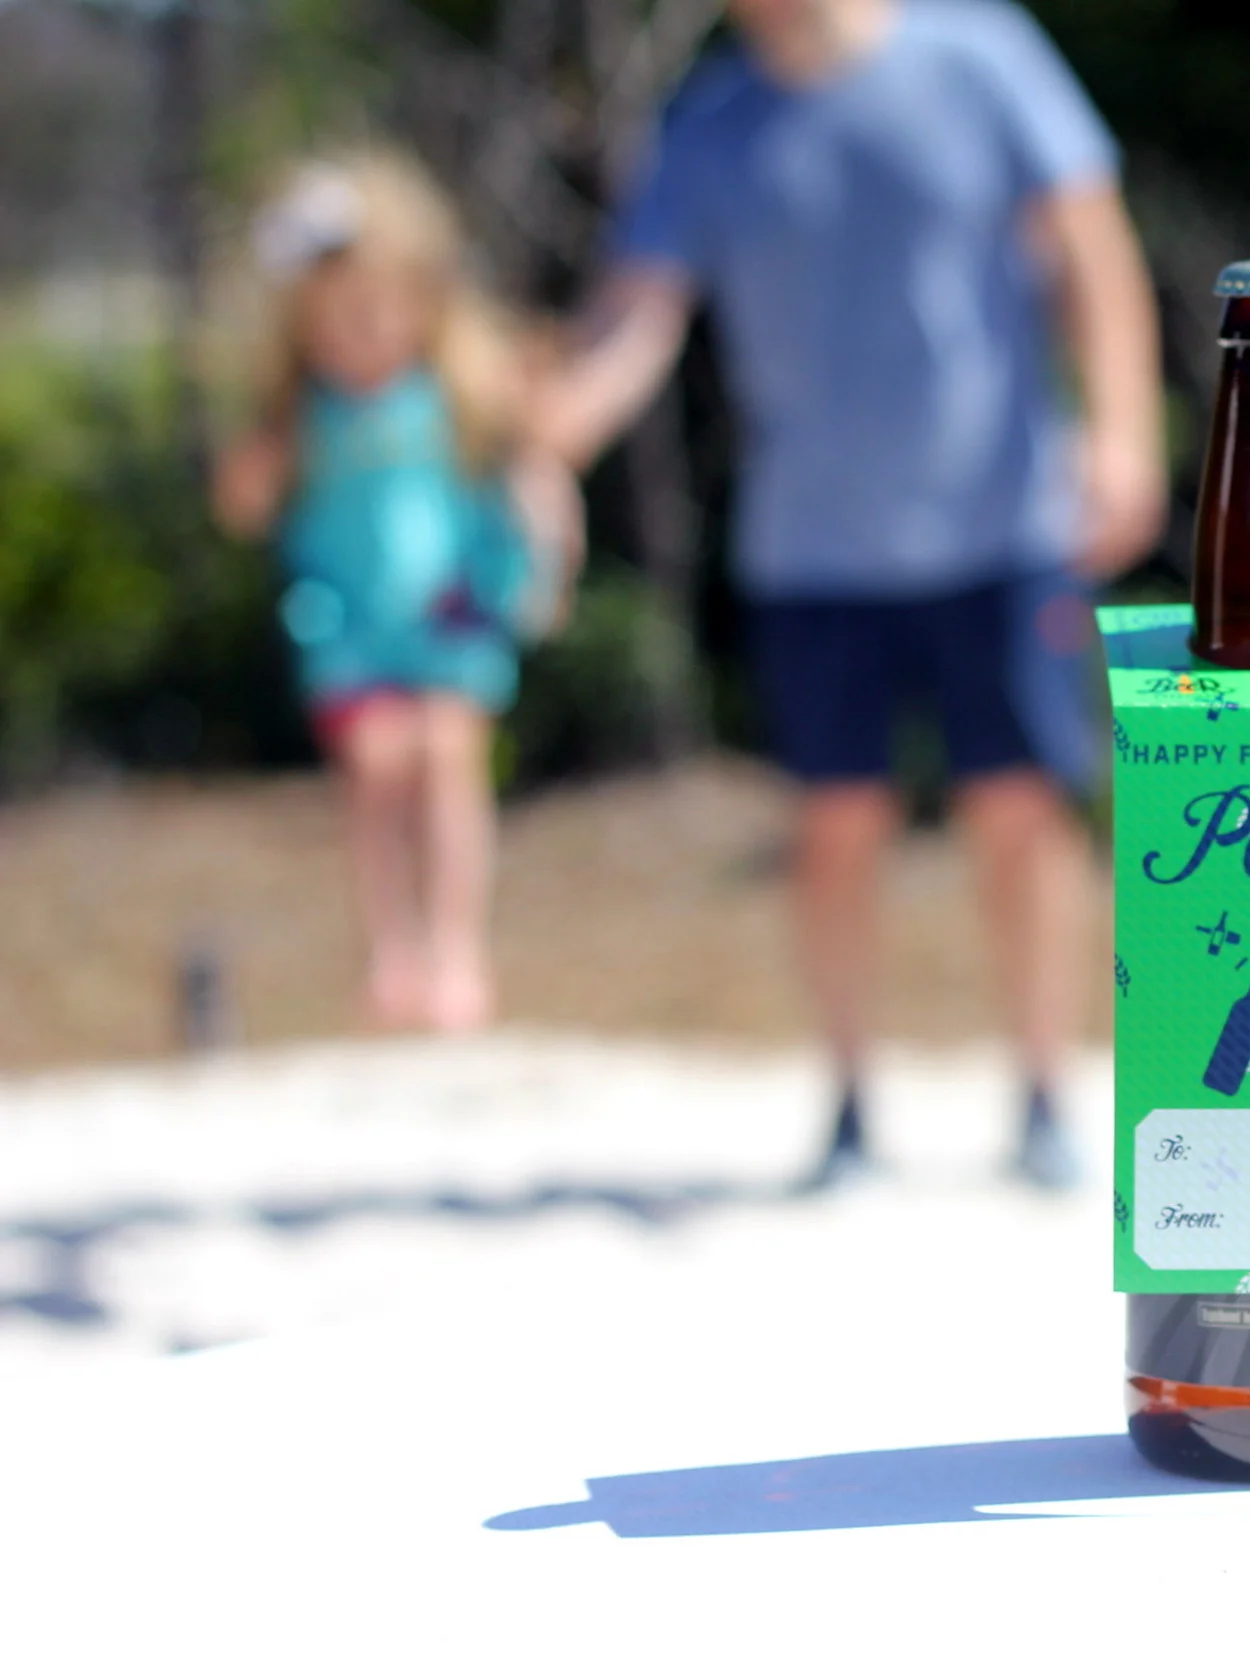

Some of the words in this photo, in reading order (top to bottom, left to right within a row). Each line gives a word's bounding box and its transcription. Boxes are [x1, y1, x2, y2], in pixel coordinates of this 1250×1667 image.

[1133, 744, 1227, 766] HAPPY
[1154, 1135, 1192, 1162] To:
[1155, 1203, 1225, 1230] From:
